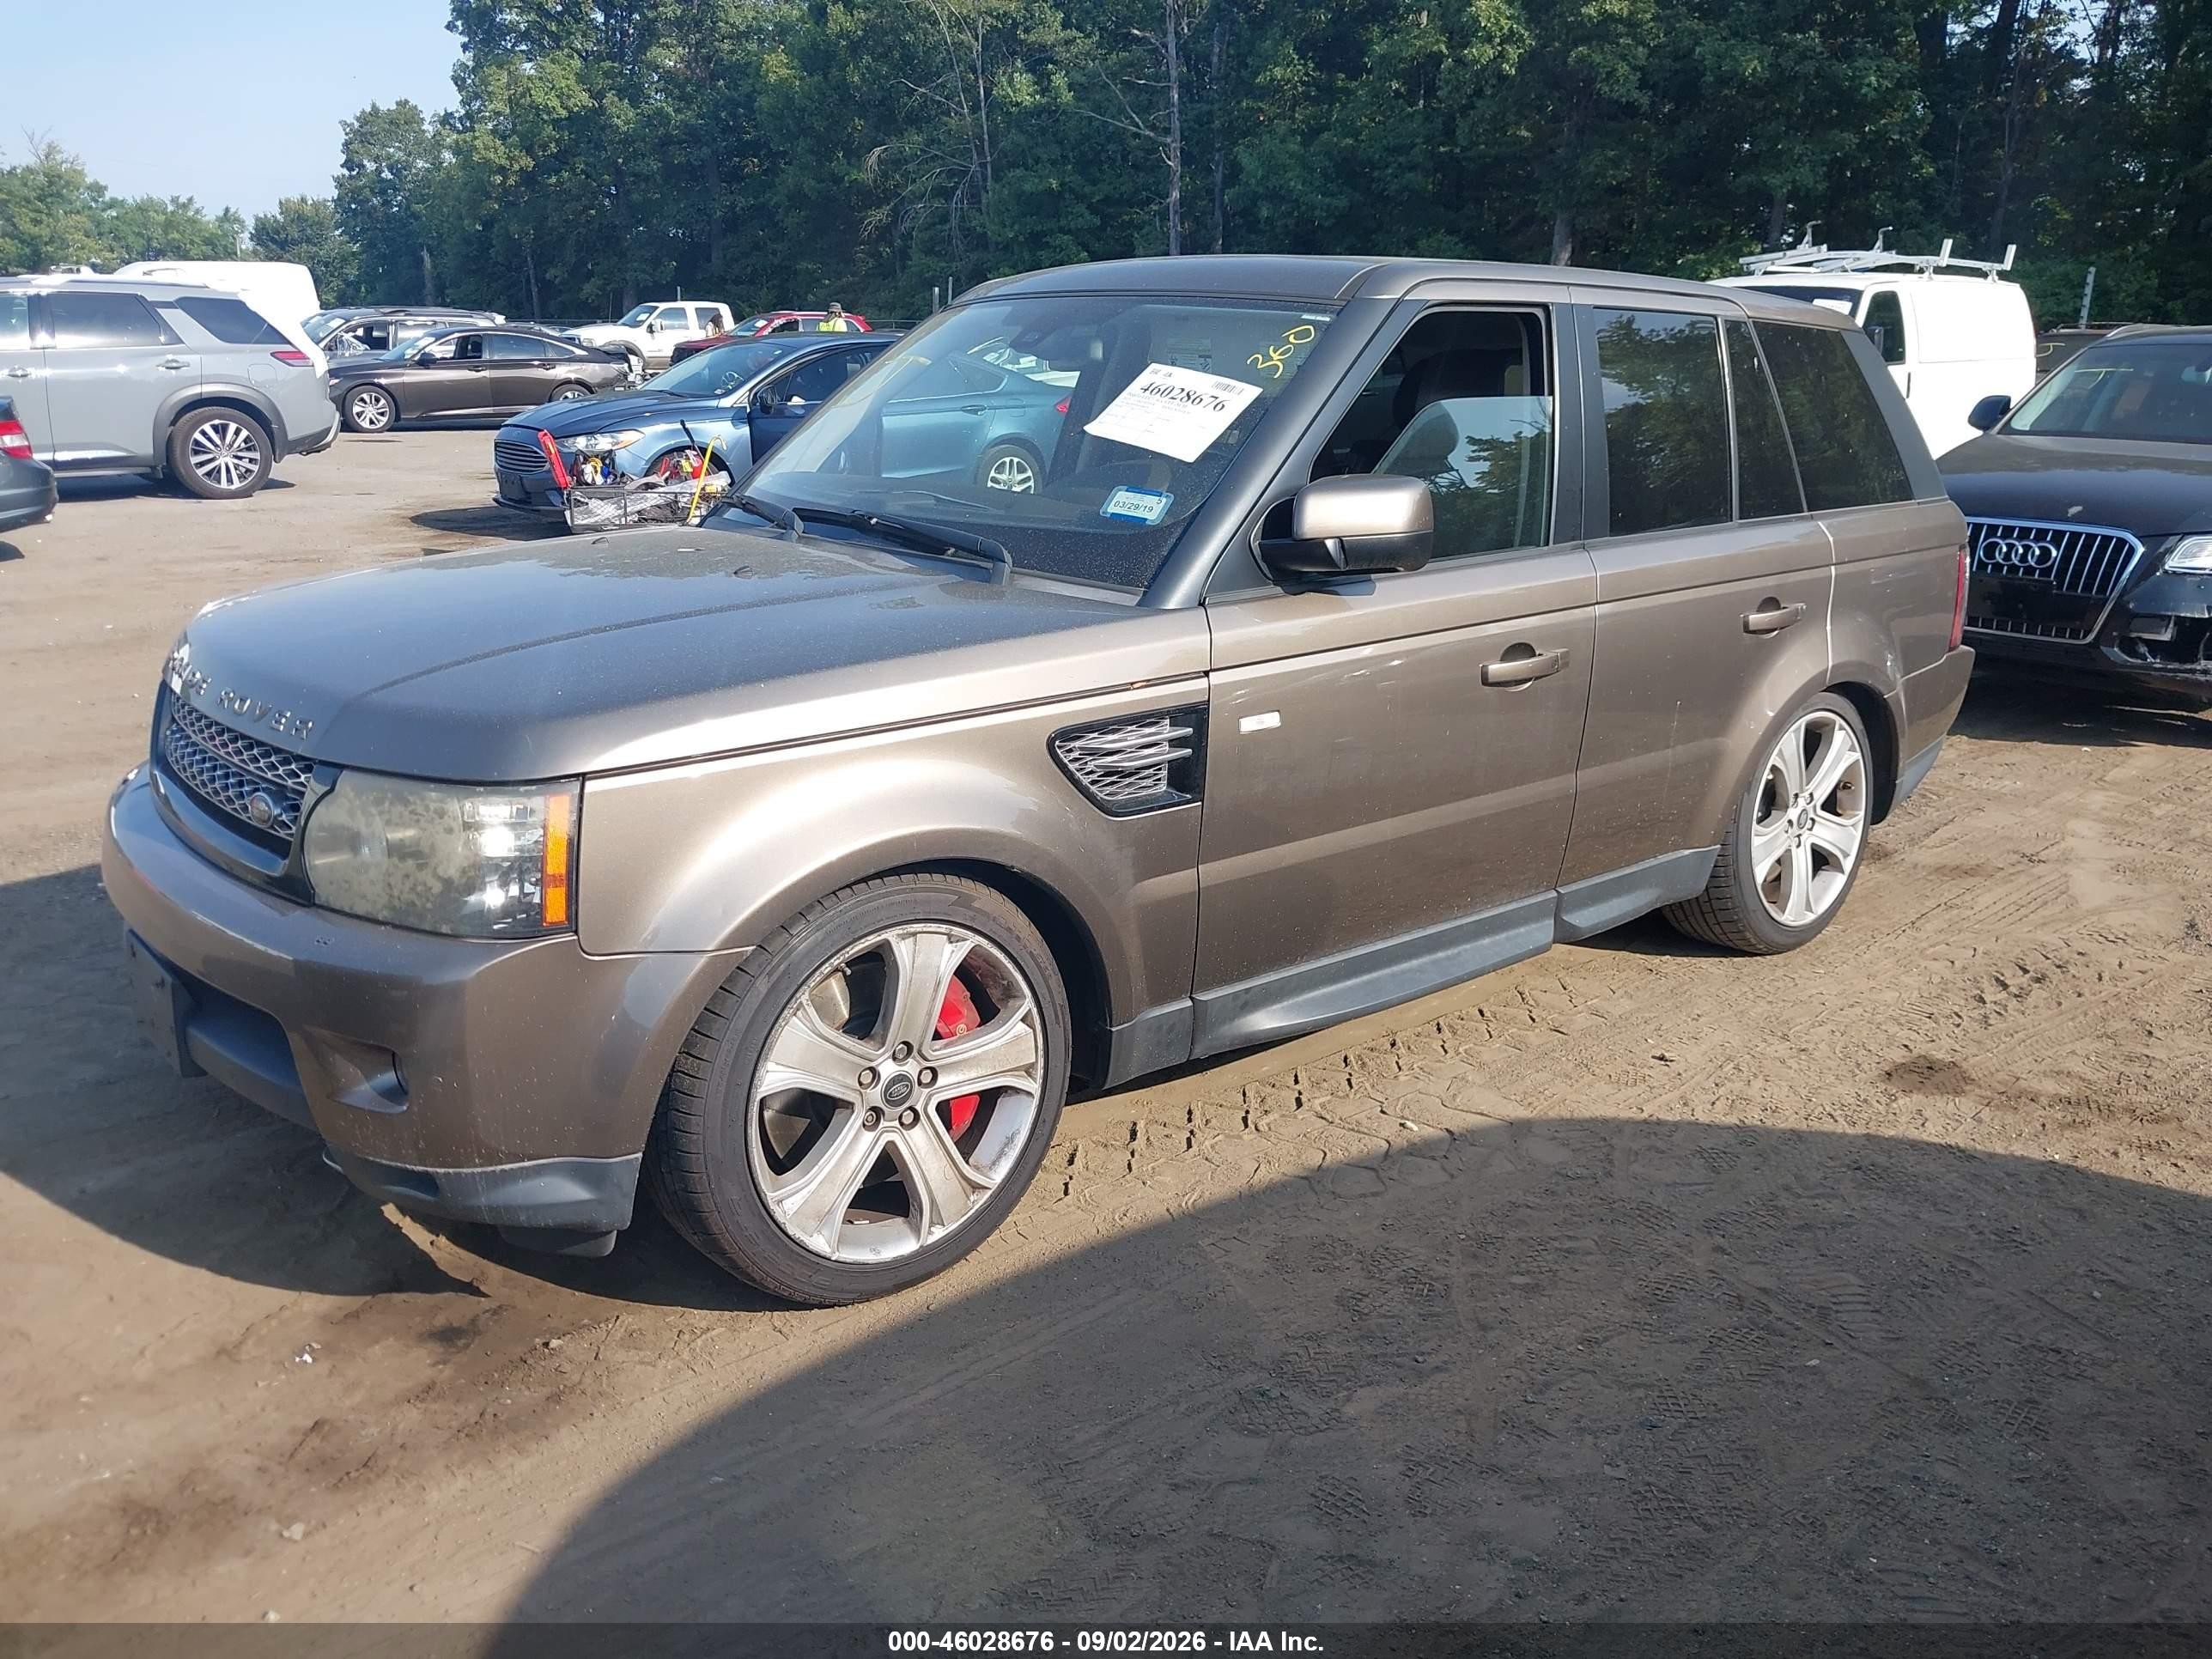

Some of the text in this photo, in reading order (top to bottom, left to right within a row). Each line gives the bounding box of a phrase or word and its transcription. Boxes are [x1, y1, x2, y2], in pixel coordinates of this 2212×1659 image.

[1247, 325, 1316, 379] 360
[1139, 380, 1231, 412] 46028676
[1113, 500, 1154, 514] 03/29/19
[217, 687, 314, 740] ROVER
